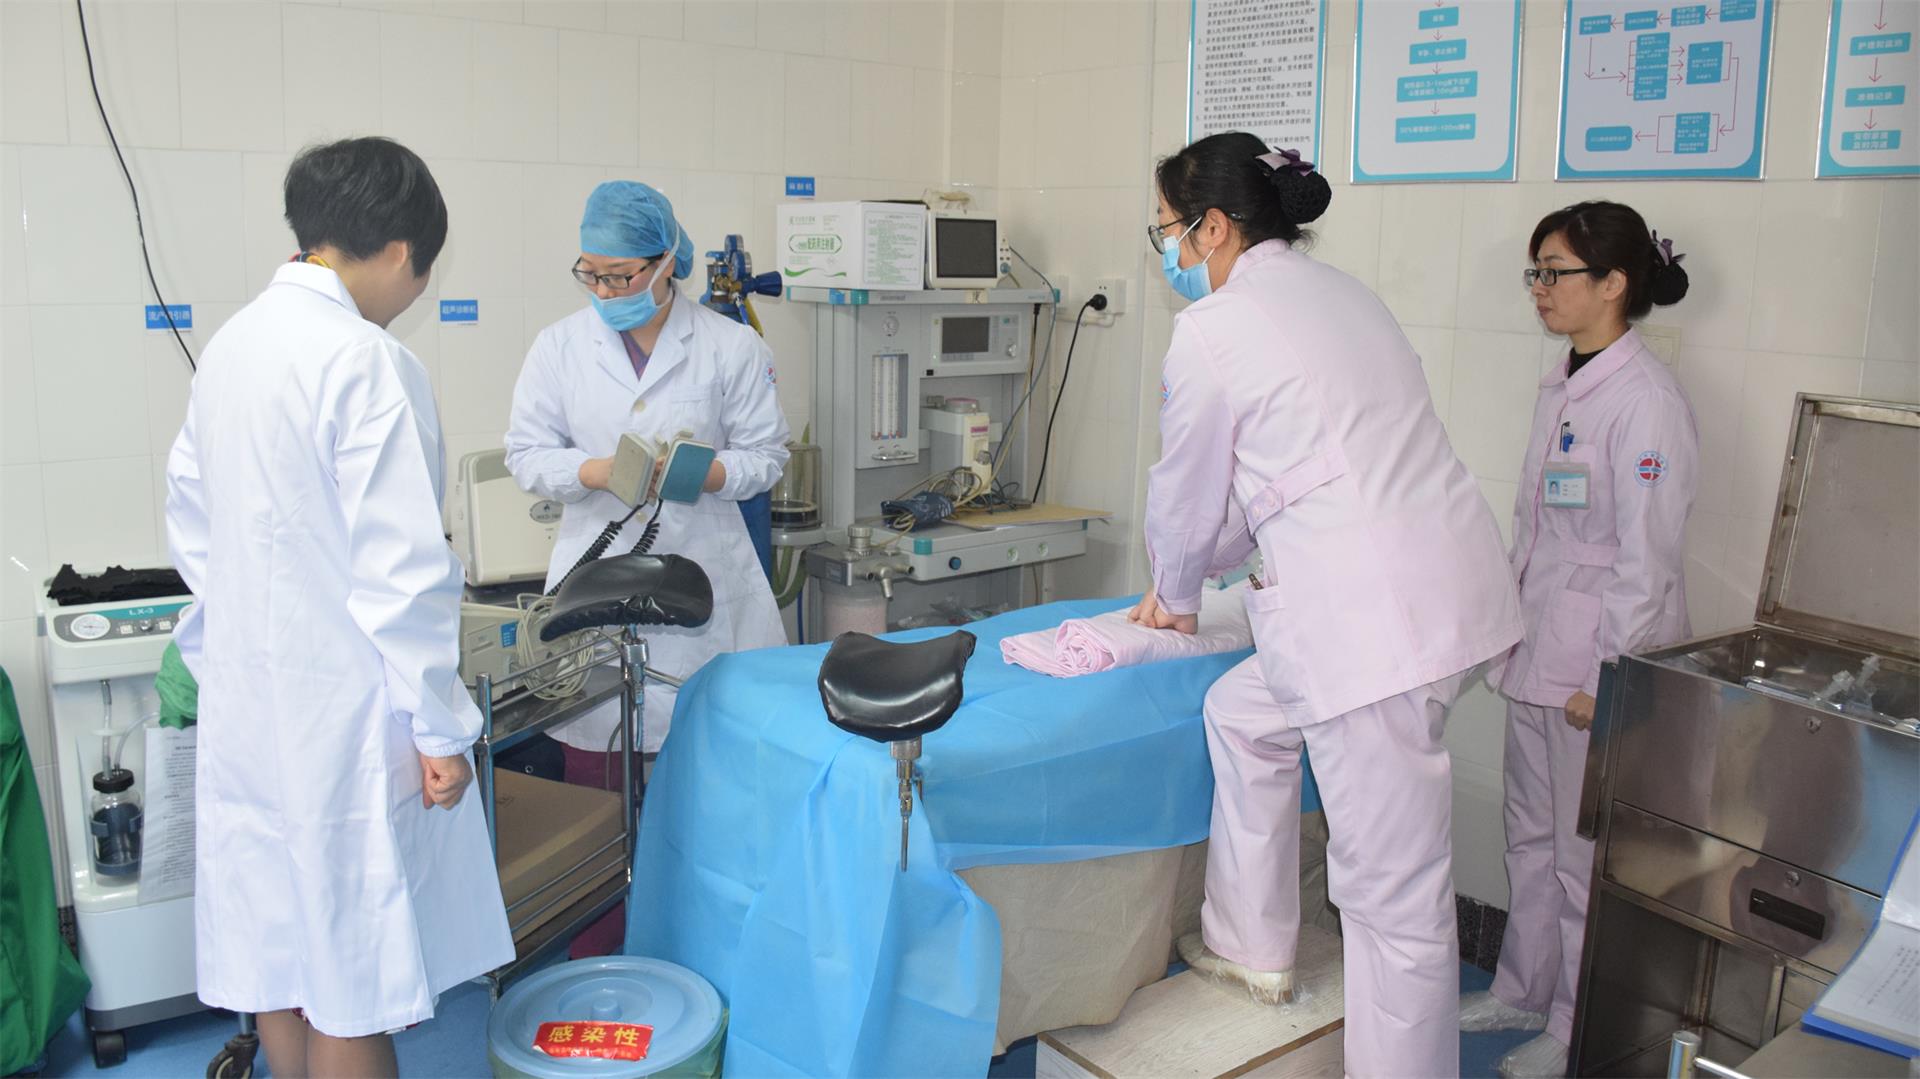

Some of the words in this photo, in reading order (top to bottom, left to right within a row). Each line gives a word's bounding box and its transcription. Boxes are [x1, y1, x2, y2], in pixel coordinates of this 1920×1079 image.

[128, 607, 154, 616] LX-3
[548, 1023, 640, 1047] 感染性
